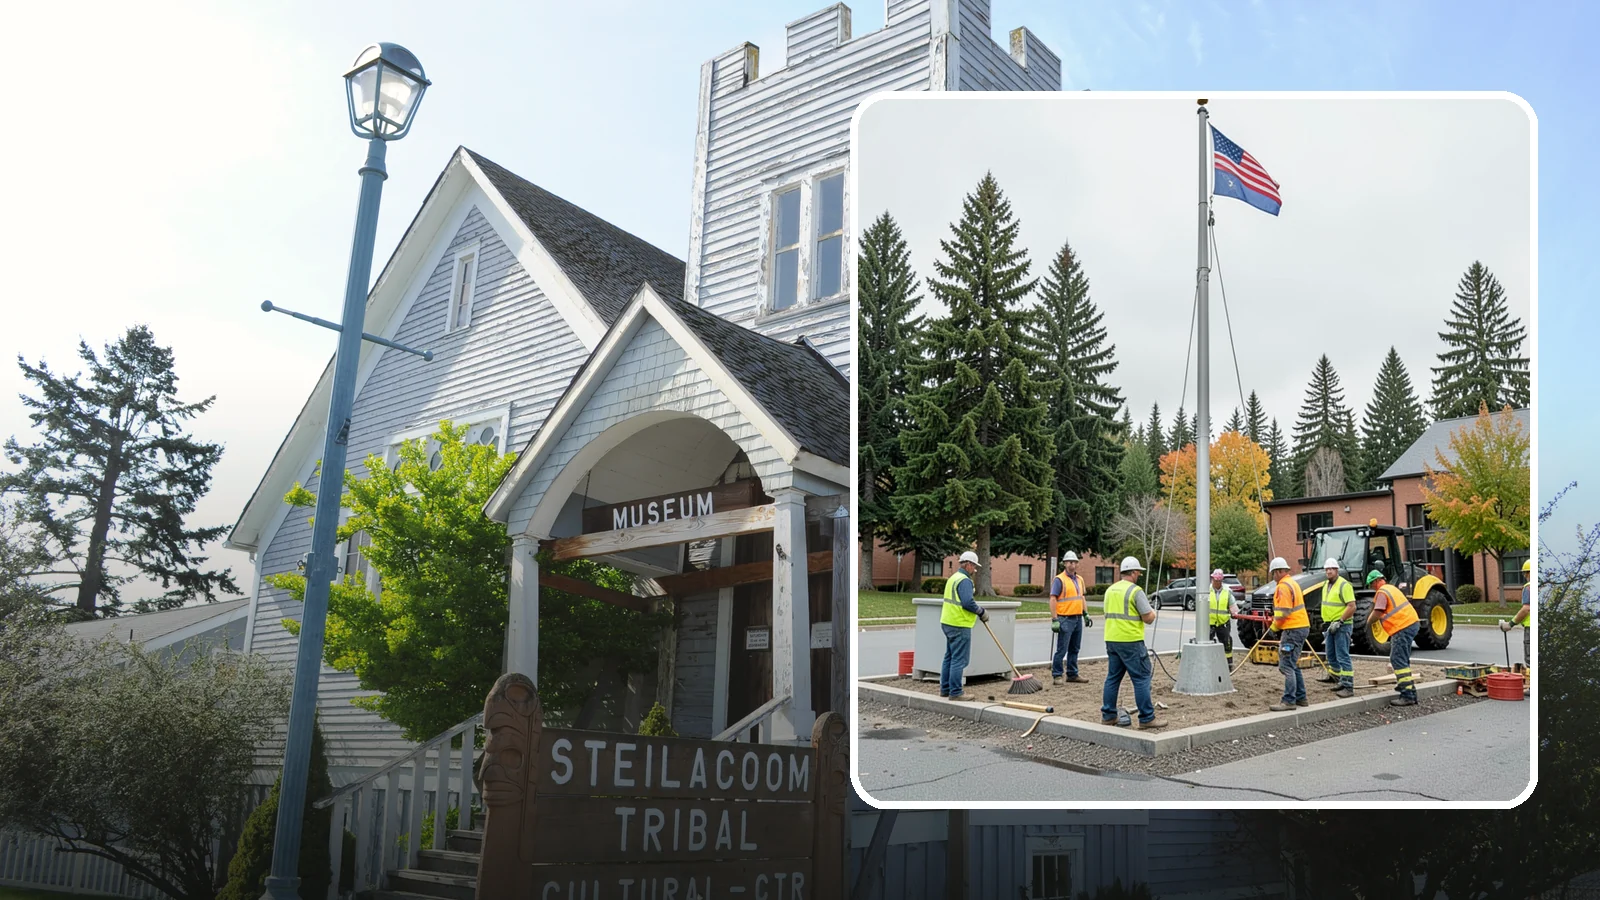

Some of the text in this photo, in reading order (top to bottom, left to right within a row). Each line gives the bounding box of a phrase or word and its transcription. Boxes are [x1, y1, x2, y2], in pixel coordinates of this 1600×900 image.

[613, 492, 714, 531] MUSEUM
[550, 738, 809, 792] STEILACOOM
[615, 806, 757, 851] TRIBAL
